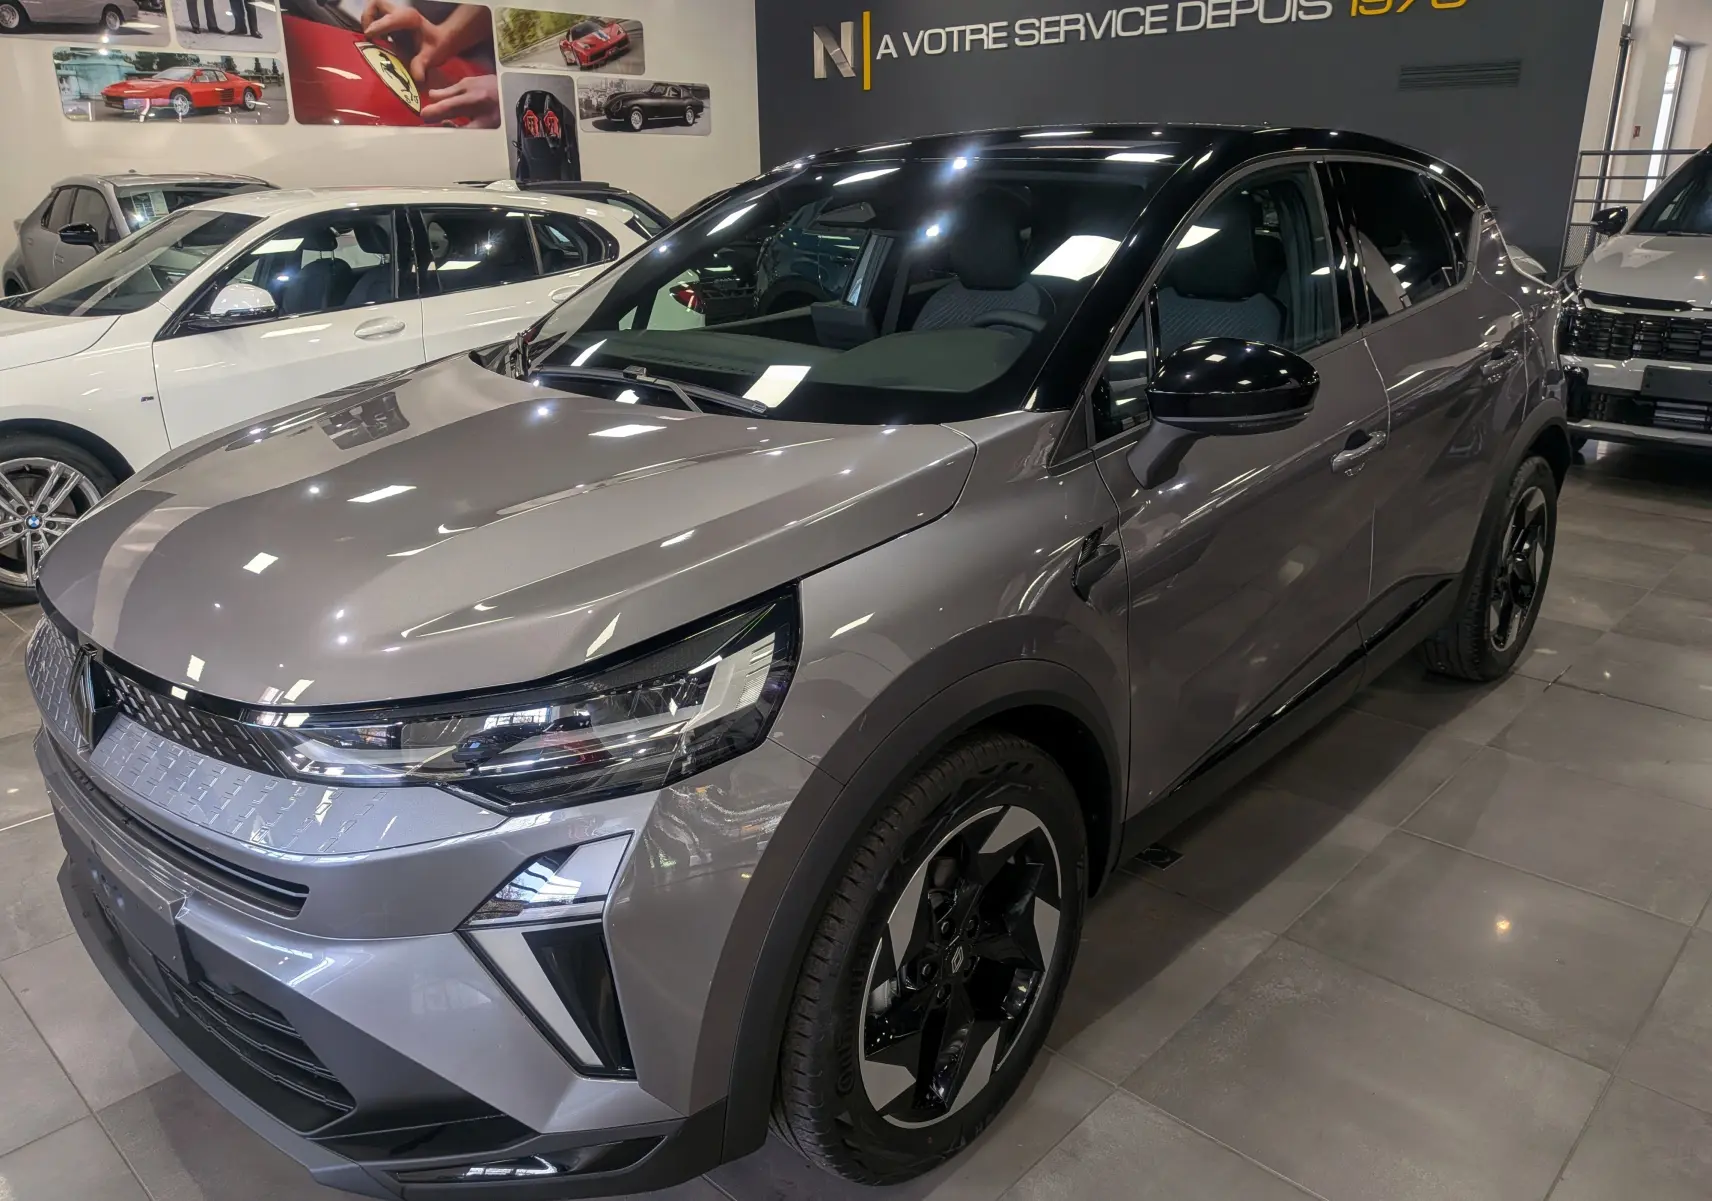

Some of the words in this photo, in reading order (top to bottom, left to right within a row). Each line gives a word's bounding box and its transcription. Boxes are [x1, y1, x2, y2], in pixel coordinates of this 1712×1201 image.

[813, 21, 856, 79] N
[876, 34, 898, 60] A
[902, 21, 1009, 57] VOTRE
[1014, 4, 1169, 46] SERVICE
[1176, 0, 1333, 32] DEPUIS
